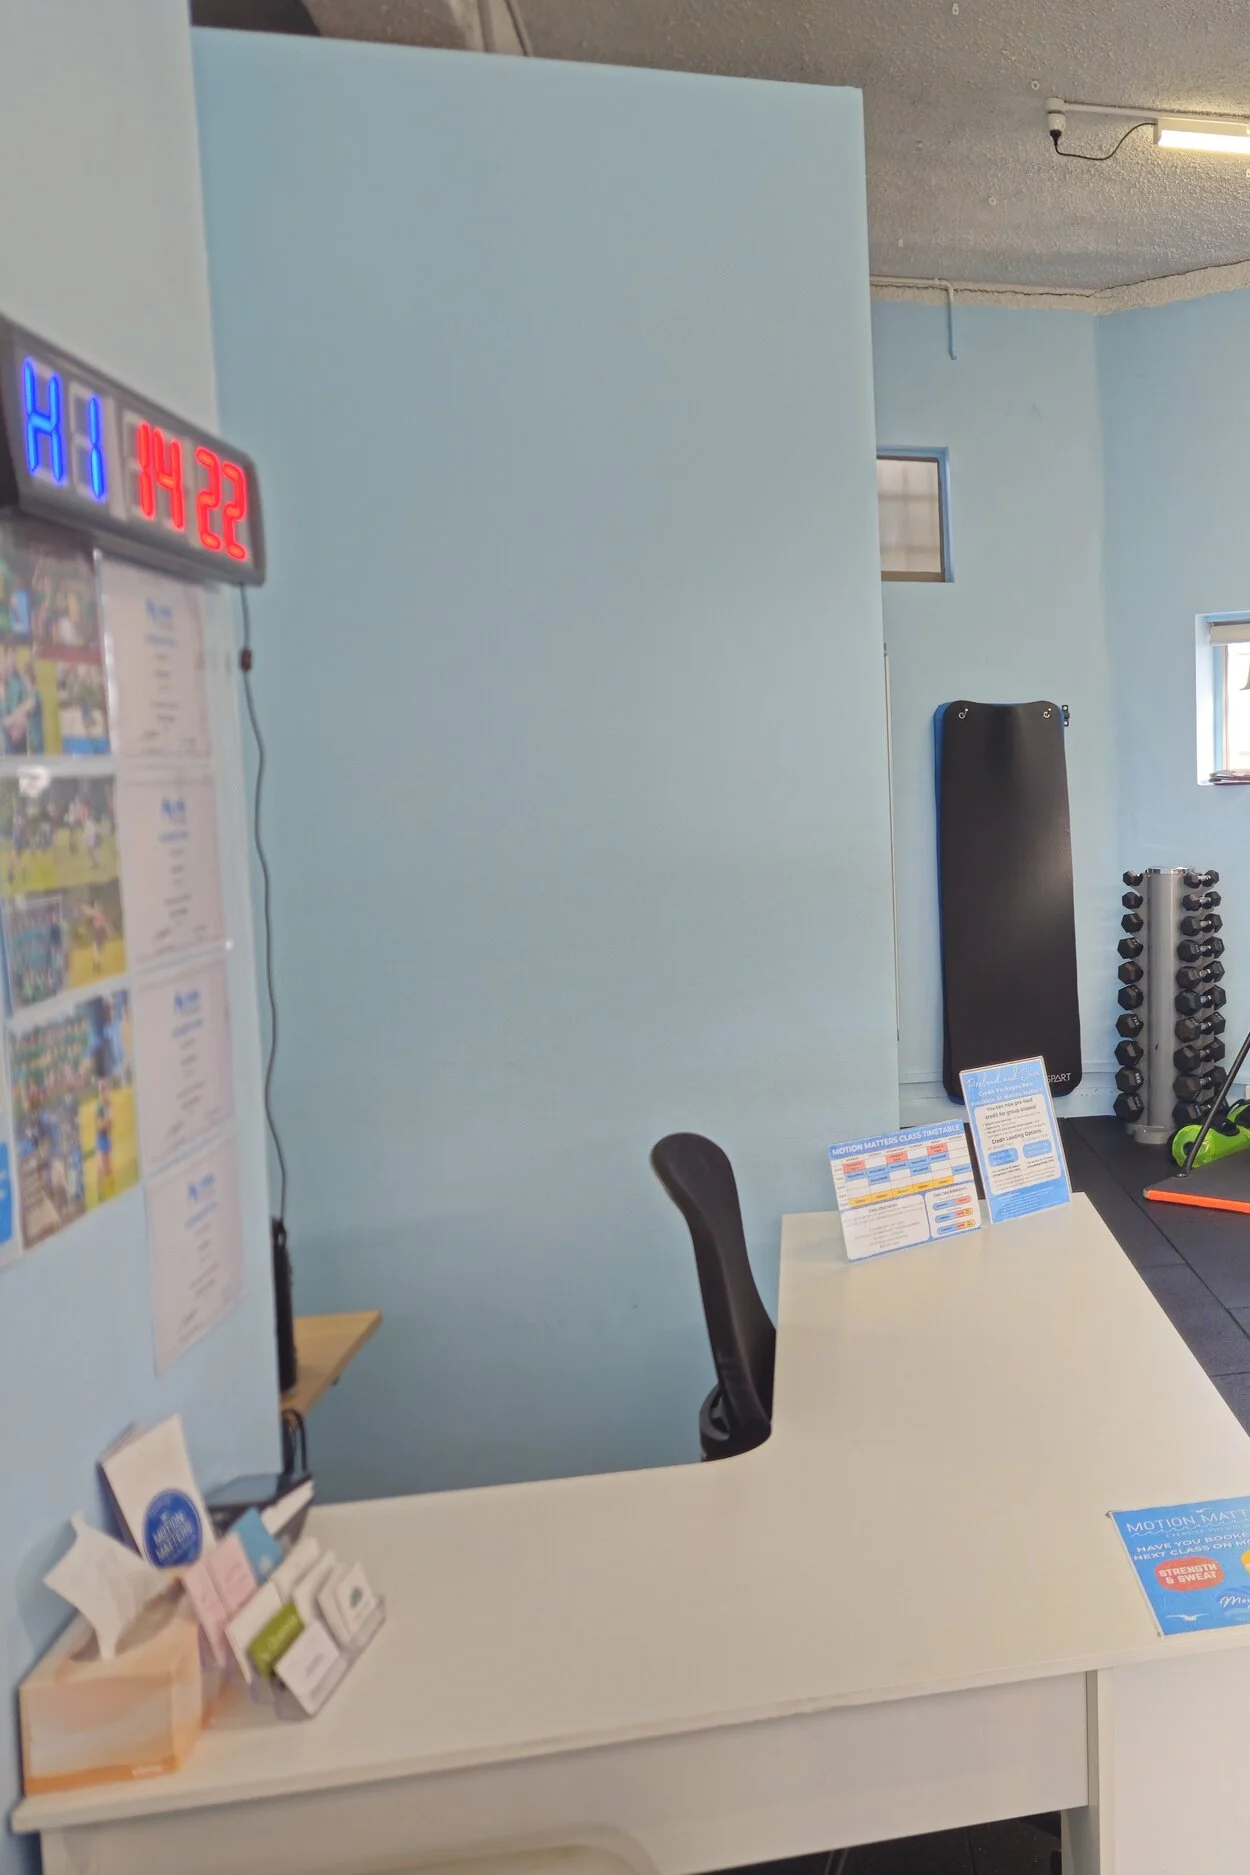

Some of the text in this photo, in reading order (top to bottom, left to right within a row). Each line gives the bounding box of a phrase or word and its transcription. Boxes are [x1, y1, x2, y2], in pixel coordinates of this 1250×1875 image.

[831, 1142, 863, 1156] MOTION
[864, 1136, 899, 1150] MATTERS
[899, 1131, 922, 1144] CLASS
[923, 1123, 961, 1137] TIMETABLE
[1126, 1515, 1196, 1533] MOTION
[1133, 1551, 1168, 1561] NEXT
[1169, 1544, 1211, 1556] CLASS
[1212, 1541, 1233, 1551] ON
[1136, 1543, 1172, 1553] HAVE
[1174, 1538, 1202, 1548] YOU
[1158, 1562, 1218, 1578] STRENGTH
[1178, 1571, 1219, 1584] SWEAT
